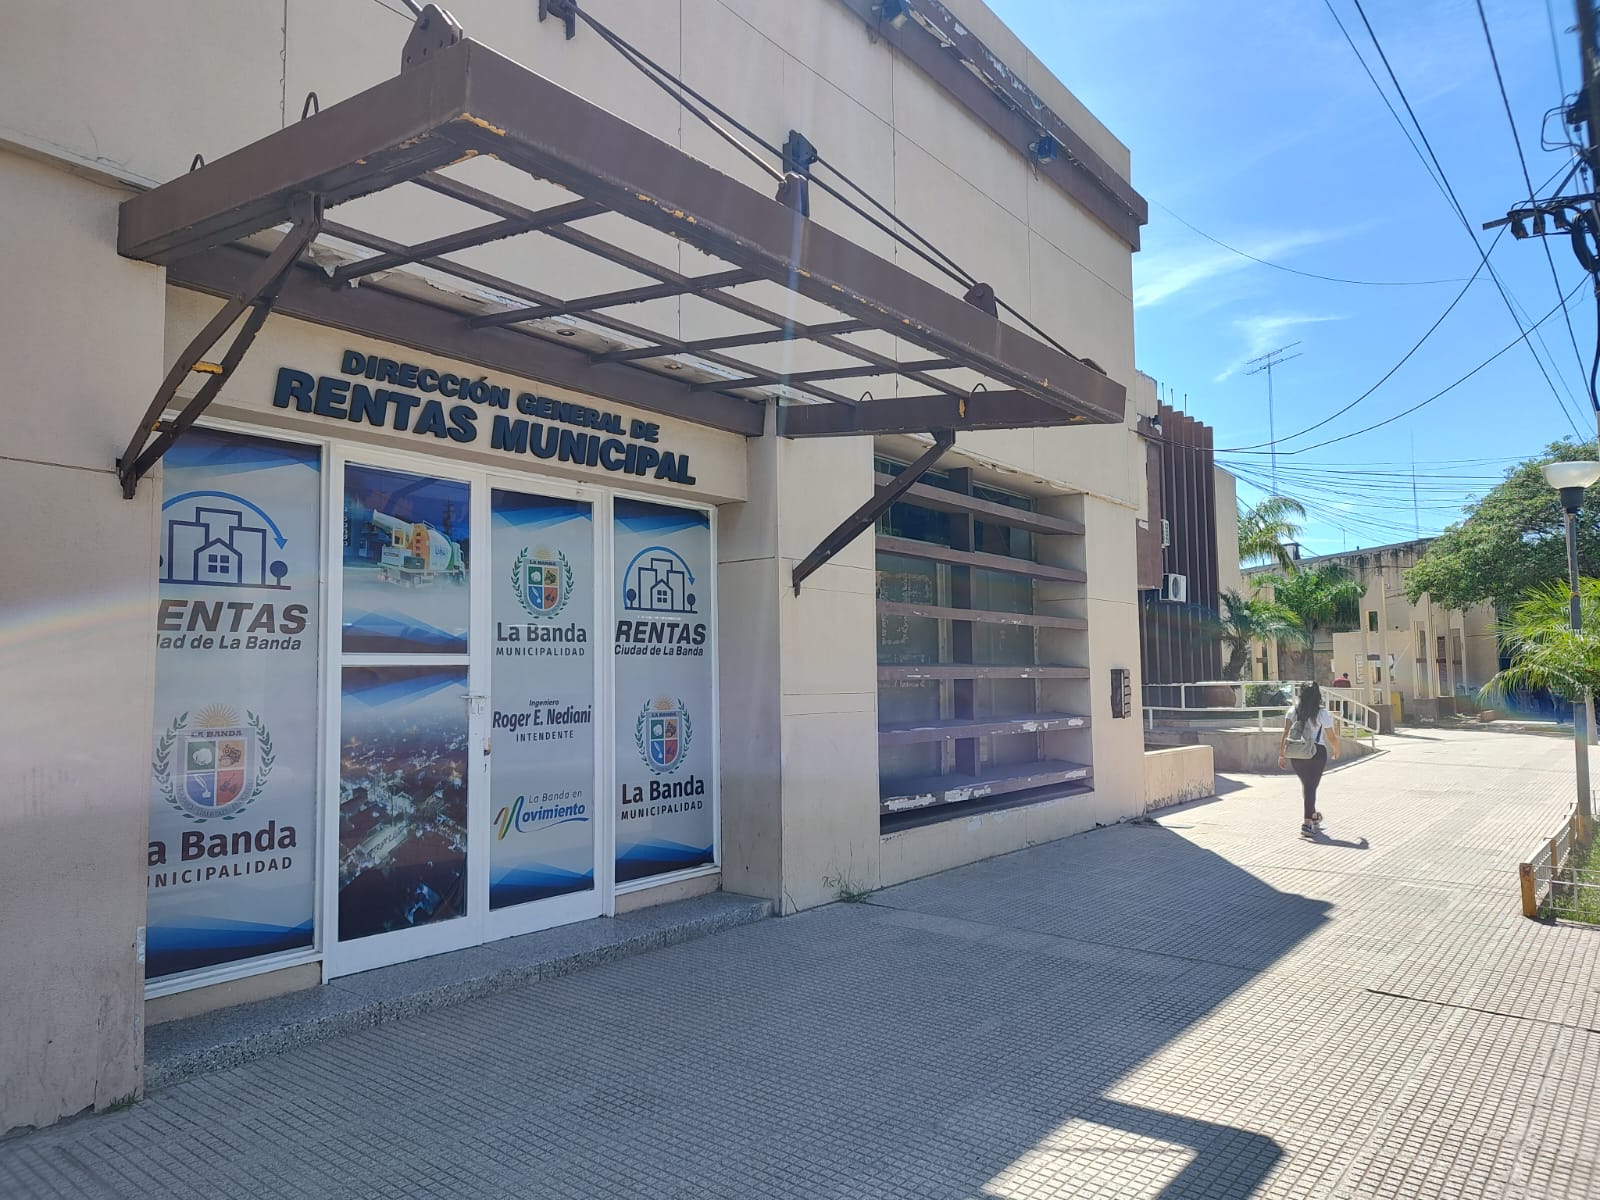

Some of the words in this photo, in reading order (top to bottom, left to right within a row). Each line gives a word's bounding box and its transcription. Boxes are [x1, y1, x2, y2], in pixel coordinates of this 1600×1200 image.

[341, 350, 510, 409] DIRECCIÓN
[516, 392, 626, 436] GENERAL
[630, 419, 660, 443] DE
[272, 367, 478, 443] RENTAS
[490, 415, 697, 485] MUNICIPAL
[157, 599, 309, 635] ENTAS
[190, 634, 214, 649] de
[218, 635, 241, 650] La
[245, 636, 302, 651] Banda
[497, 622, 520, 642] La
[527, 622, 587, 643] Banda
[615, 620, 706, 645] RENTAS
[496, 647, 585, 657] MUNICIPALIDAD
[614, 644, 648, 656] Ciudad
[650, 645, 661, 656] de
[663, 646, 674, 656] La
[676, 646, 704, 656] Banda
[529, 698, 560, 708] Ingeniero
[492, 710, 532, 732] Roger
[533, 709, 544, 726] E.
[546, 704, 592, 726] Nediani
[206, 729, 243, 738] BANDA
[516, 730, 574, 742] INTENDENTE
[528, 794, 539, 804] La
[542, 790, 570, 802] Banda
[572, 790, 582, 798] en
[622, 783, 643, 805] La
[649, 774, 705, 802] Banda
[621, 800, 703, 821] MUNICIPALIDAD
[148, 840, 167, 867] a
[181, 820, 297, 862] Banda
[147, 856, 292, 888] NICIPALIDAD
